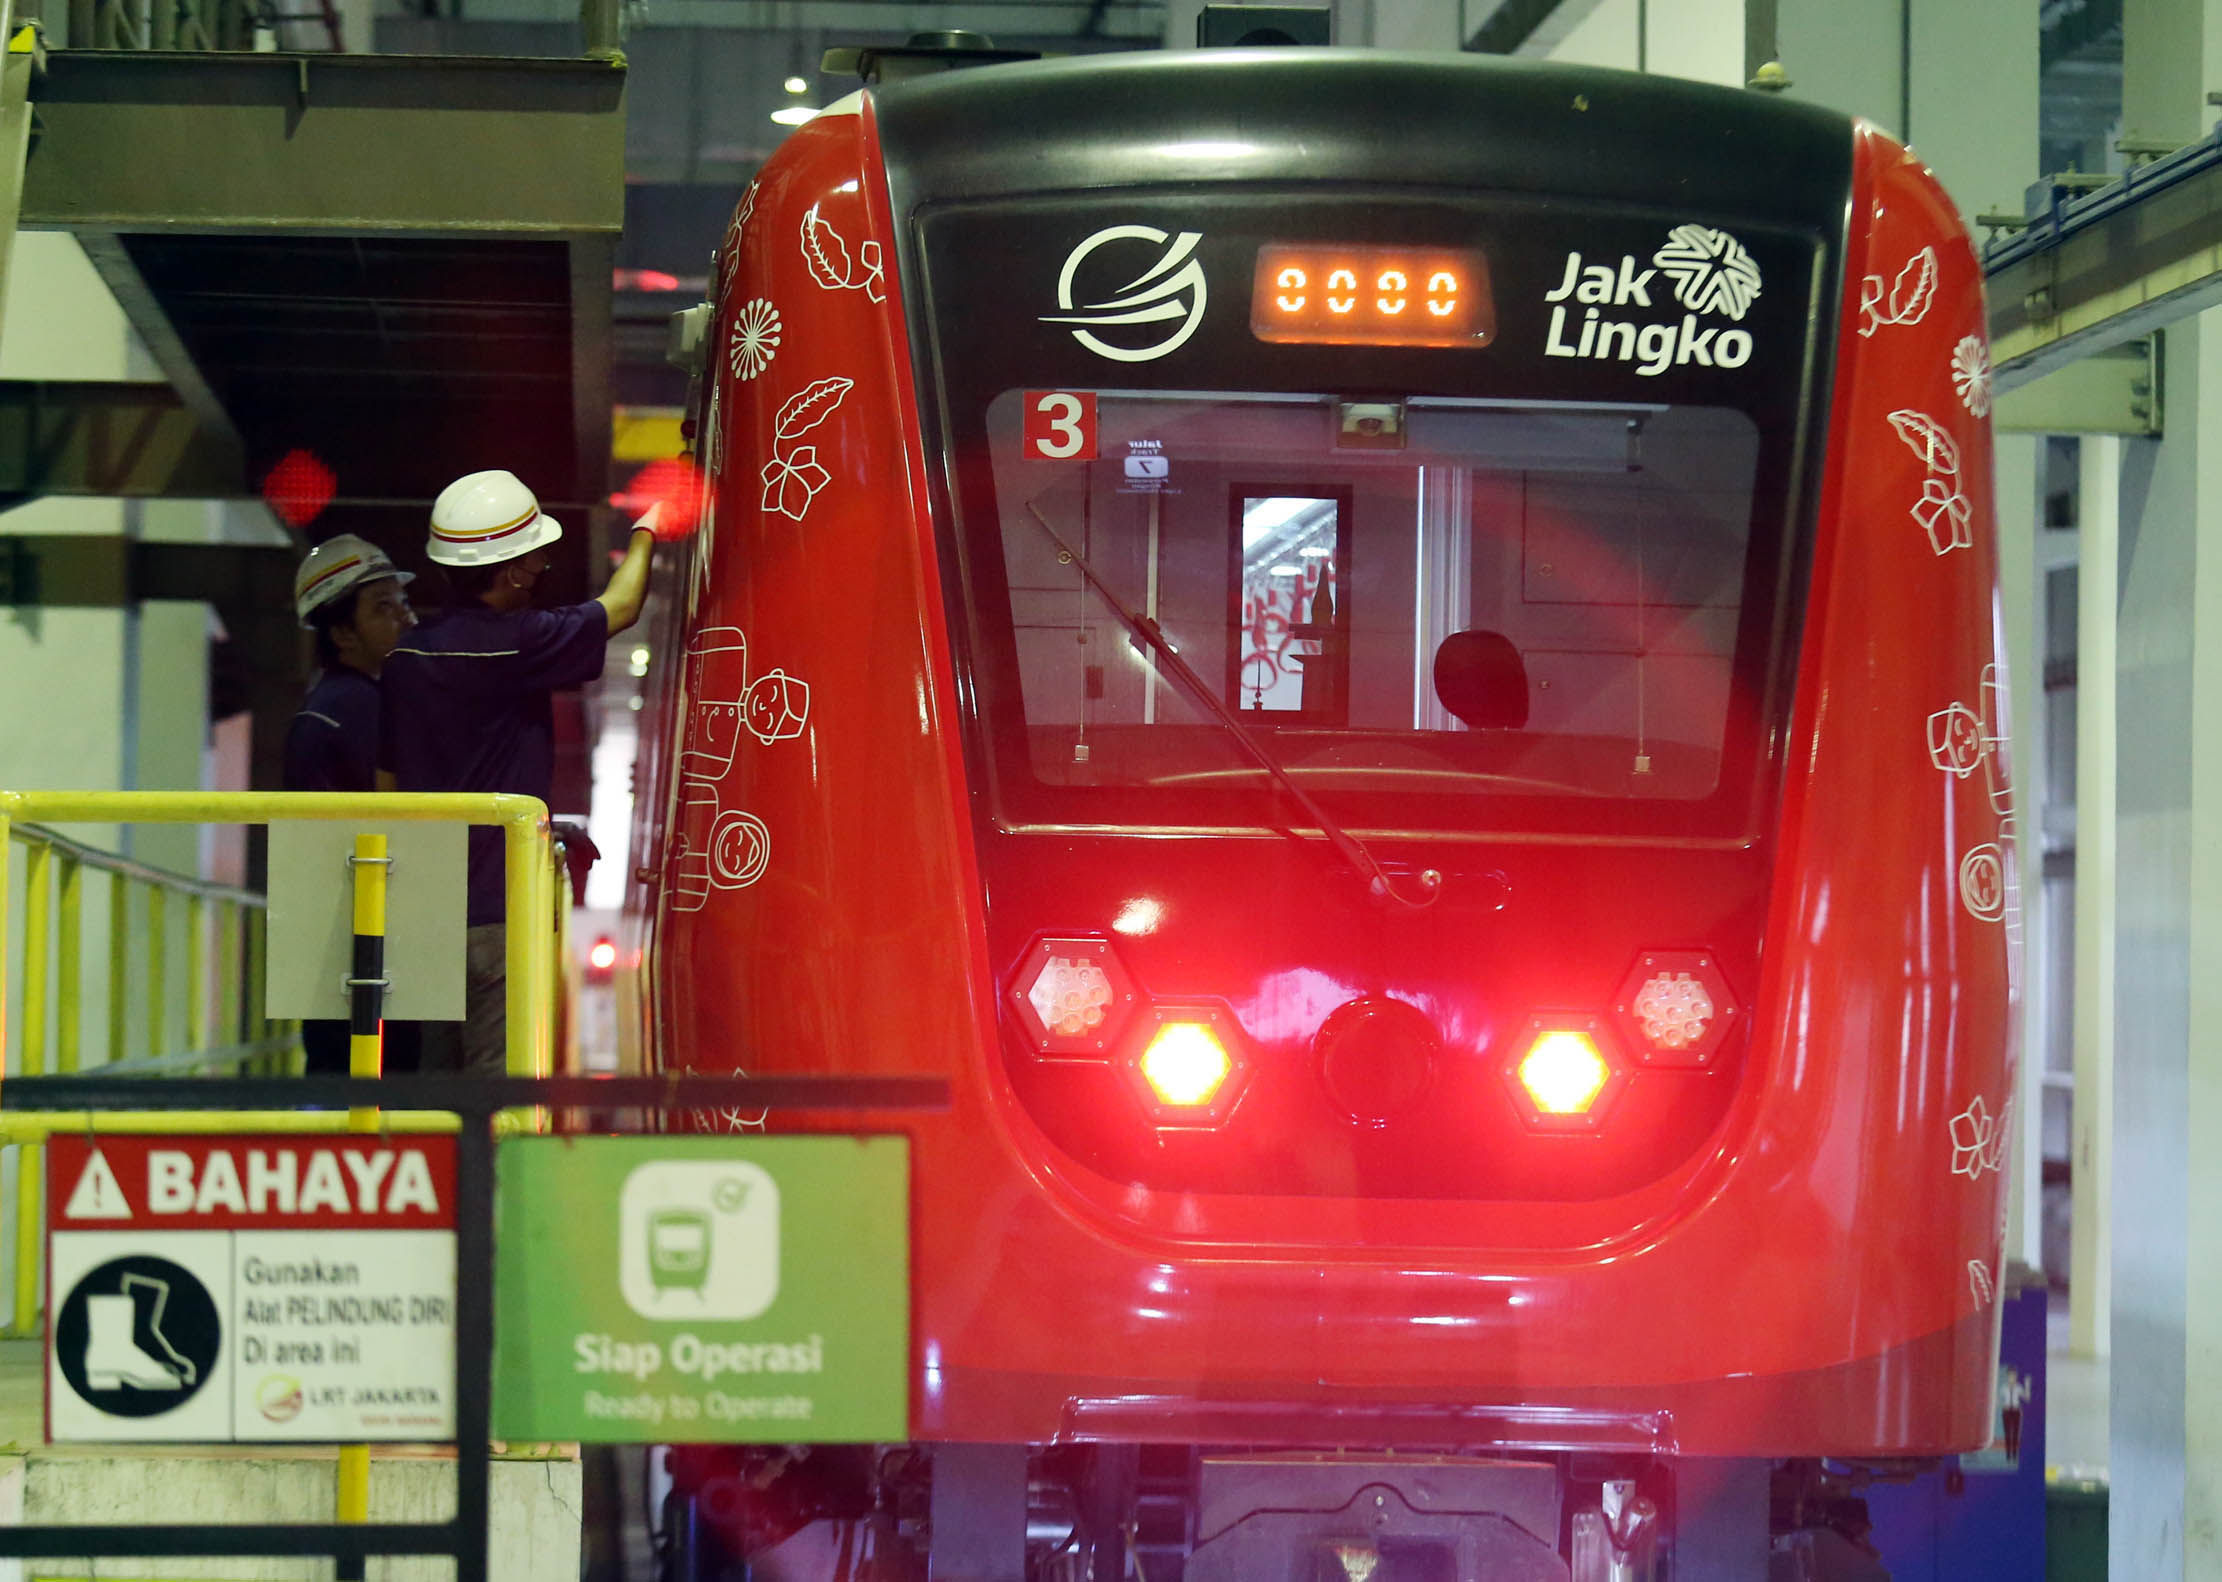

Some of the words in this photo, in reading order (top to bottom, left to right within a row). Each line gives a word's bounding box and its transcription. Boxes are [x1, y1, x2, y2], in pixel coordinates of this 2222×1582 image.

[1544, 251, 1658, 307] Jak
[1544, 305, 1753, 377] Lingko
[1036, 393, 1084, 459] 3
[147, 1149, 440, 1215] BAHAYA
[243, 1255, 360, 1285] Gunakan
[286, 1296, 403, 1325] PELINDUNG
[243, 1335, 268, 1364] Di
[273, 1342, 325, 1364] area
[331, 1335, 361, 1364] ini
[573, 1332, 662, 1382] Siap
[669, 1331, 823, 1382] Operasi
[308, 1387, 346, 1405] LRT
[352, 1386, 440, 1405] JAKARTA
[585, 1389, 665, 1424] Ready
[669, 1393, 701, 1420] to
[705, 1389, 813, 1424] Operate
